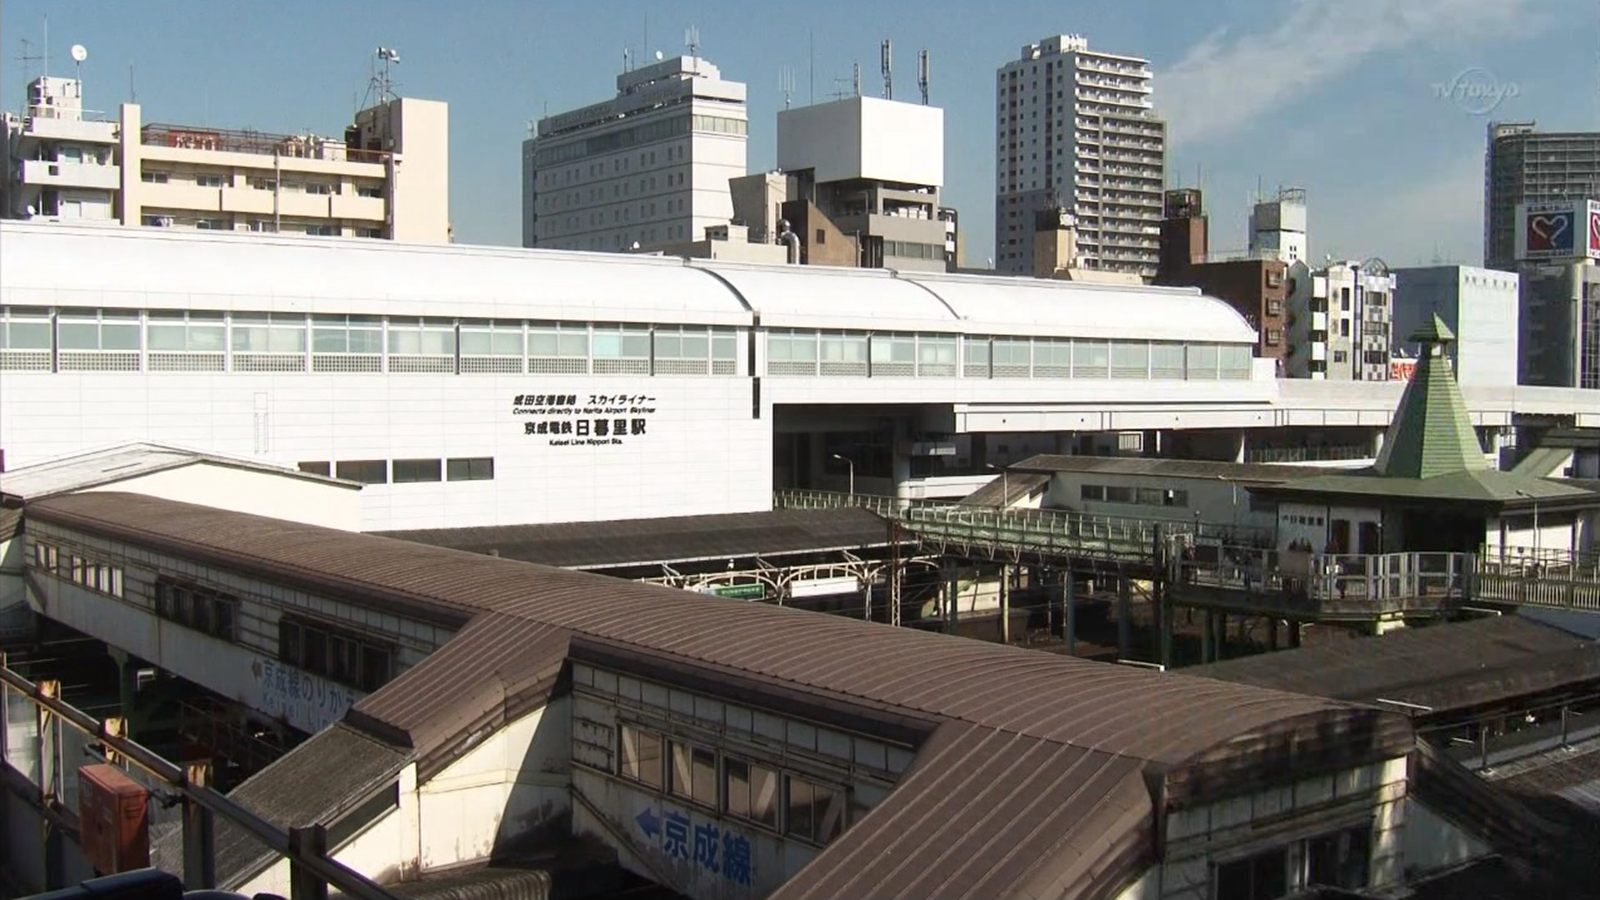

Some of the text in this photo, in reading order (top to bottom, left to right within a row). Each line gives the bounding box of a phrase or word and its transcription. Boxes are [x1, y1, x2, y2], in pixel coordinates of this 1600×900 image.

[513, 394, 656, 406] 成田空港直結 スカイライナー
[513, 407, 546, 415] Connects
[547, 407, 573, 416] directly
[583, 407, 603, 415] Narita
[604, 407, 627, 415] Airport
[630, 407, 656, 415] Skyliner
[663, 810, 752, 887] 京成線
